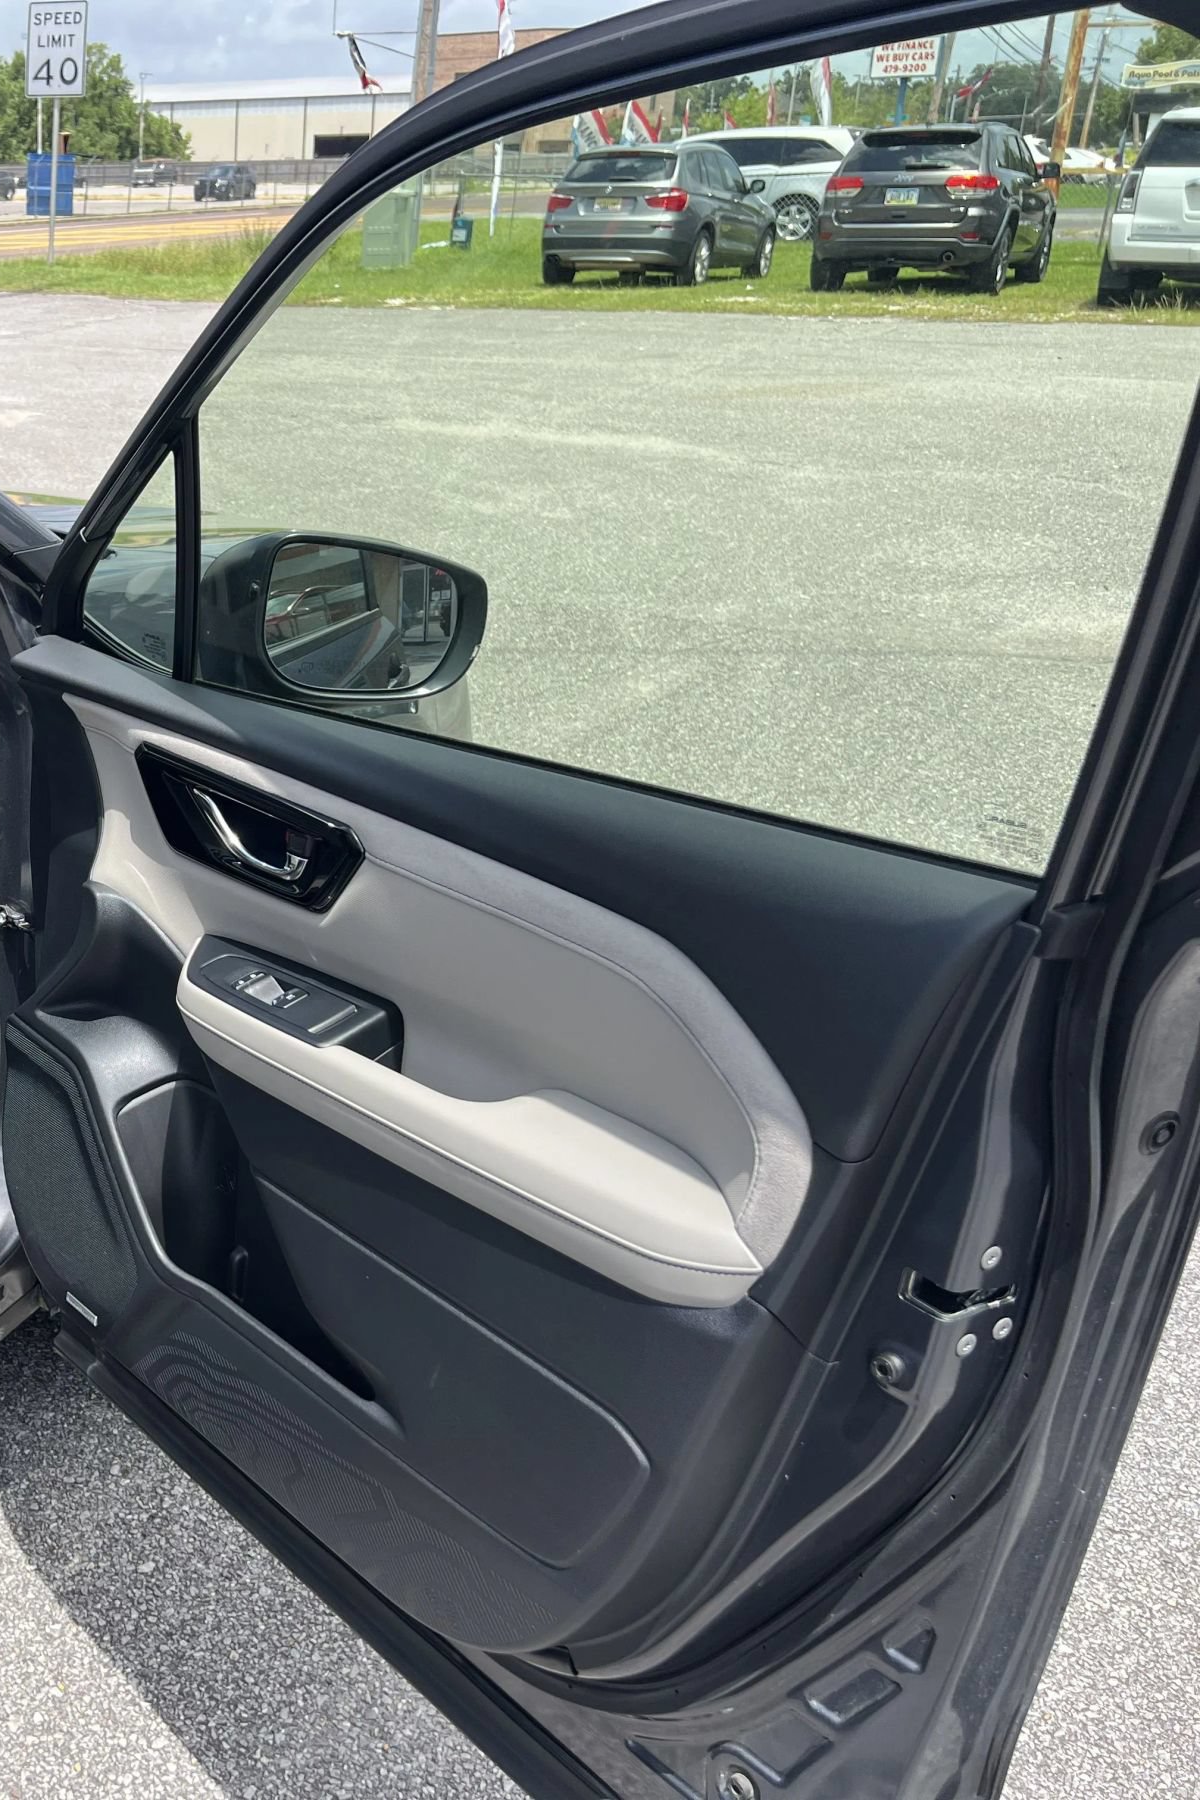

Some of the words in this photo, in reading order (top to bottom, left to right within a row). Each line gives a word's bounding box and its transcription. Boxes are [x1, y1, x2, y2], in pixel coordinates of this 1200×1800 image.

[33, 12, 82, 25] SPEED
[37, 34, 75, 48] LIMIT
[897, 40, 934, 50] FINANCE
[876, 53, 889, 62] WE
[892, 53, 909, 61] BUY
[911, 51, 935, 60] CARS
[32, 57, 78, 86] 40
[883, 63, 926, 72] 479-9200
